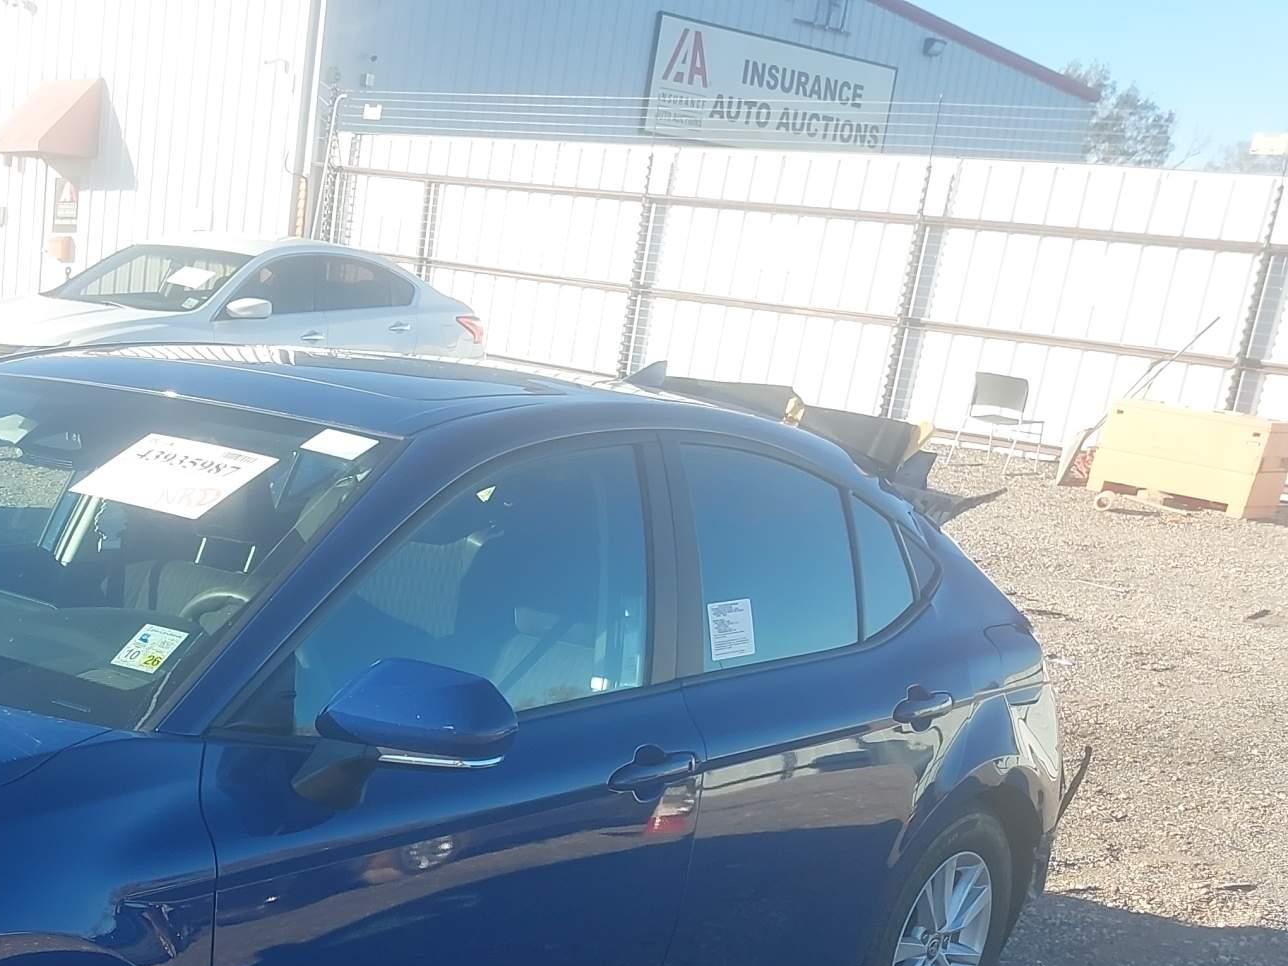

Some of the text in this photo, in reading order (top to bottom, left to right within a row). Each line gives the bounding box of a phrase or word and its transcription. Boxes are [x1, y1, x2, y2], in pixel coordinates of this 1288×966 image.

[741, 58, 865, 109] INSURANCE
[709, 93, 772, 128] AUTO
[775, 106, 880, 150] AUCTIONS
[136, 448, 241, 477] 43935987
[123, 648, 141, 660] 10
[143, 655, 162, 667] 26
